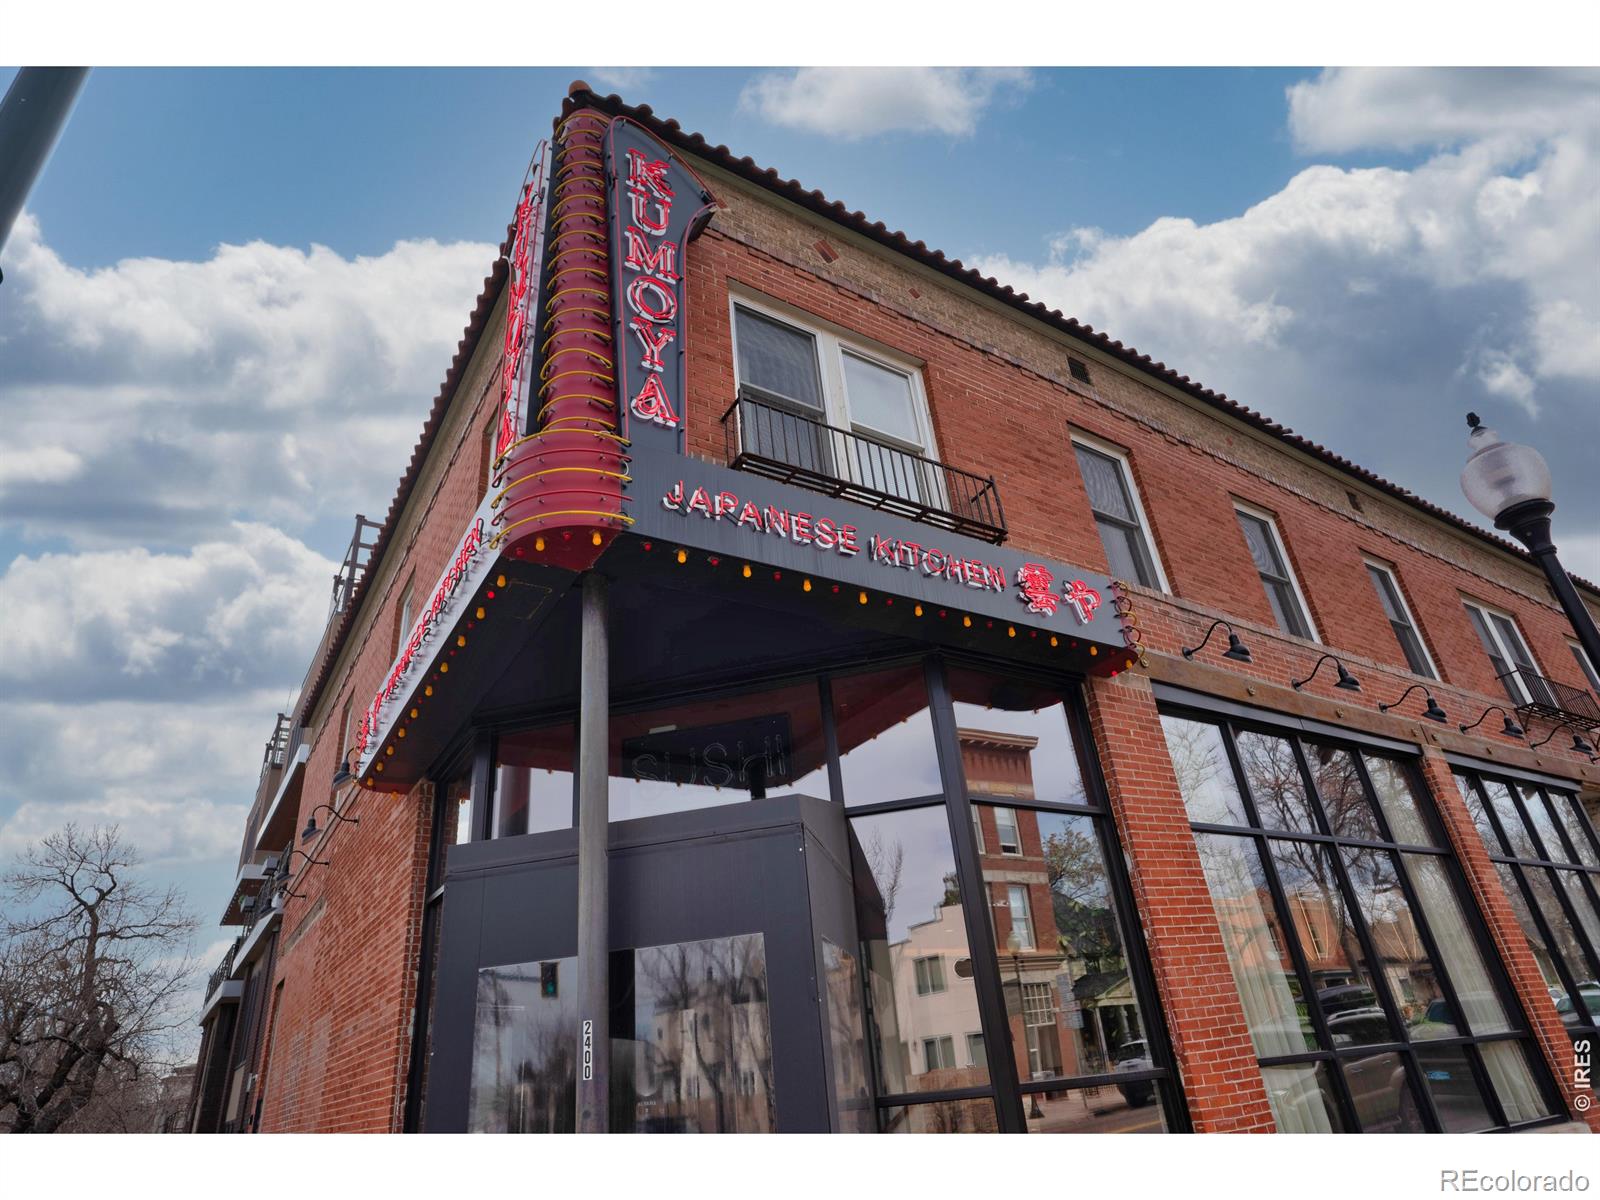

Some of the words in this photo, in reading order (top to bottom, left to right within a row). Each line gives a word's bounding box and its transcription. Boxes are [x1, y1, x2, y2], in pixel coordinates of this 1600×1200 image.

[625, 148, 681, 428] KUMOYA
[662, 480, 861, 557] JAPANESE
[868, 533, 1007, 593] KITCHEN
[584, 1021, 592, 1079] 2400
